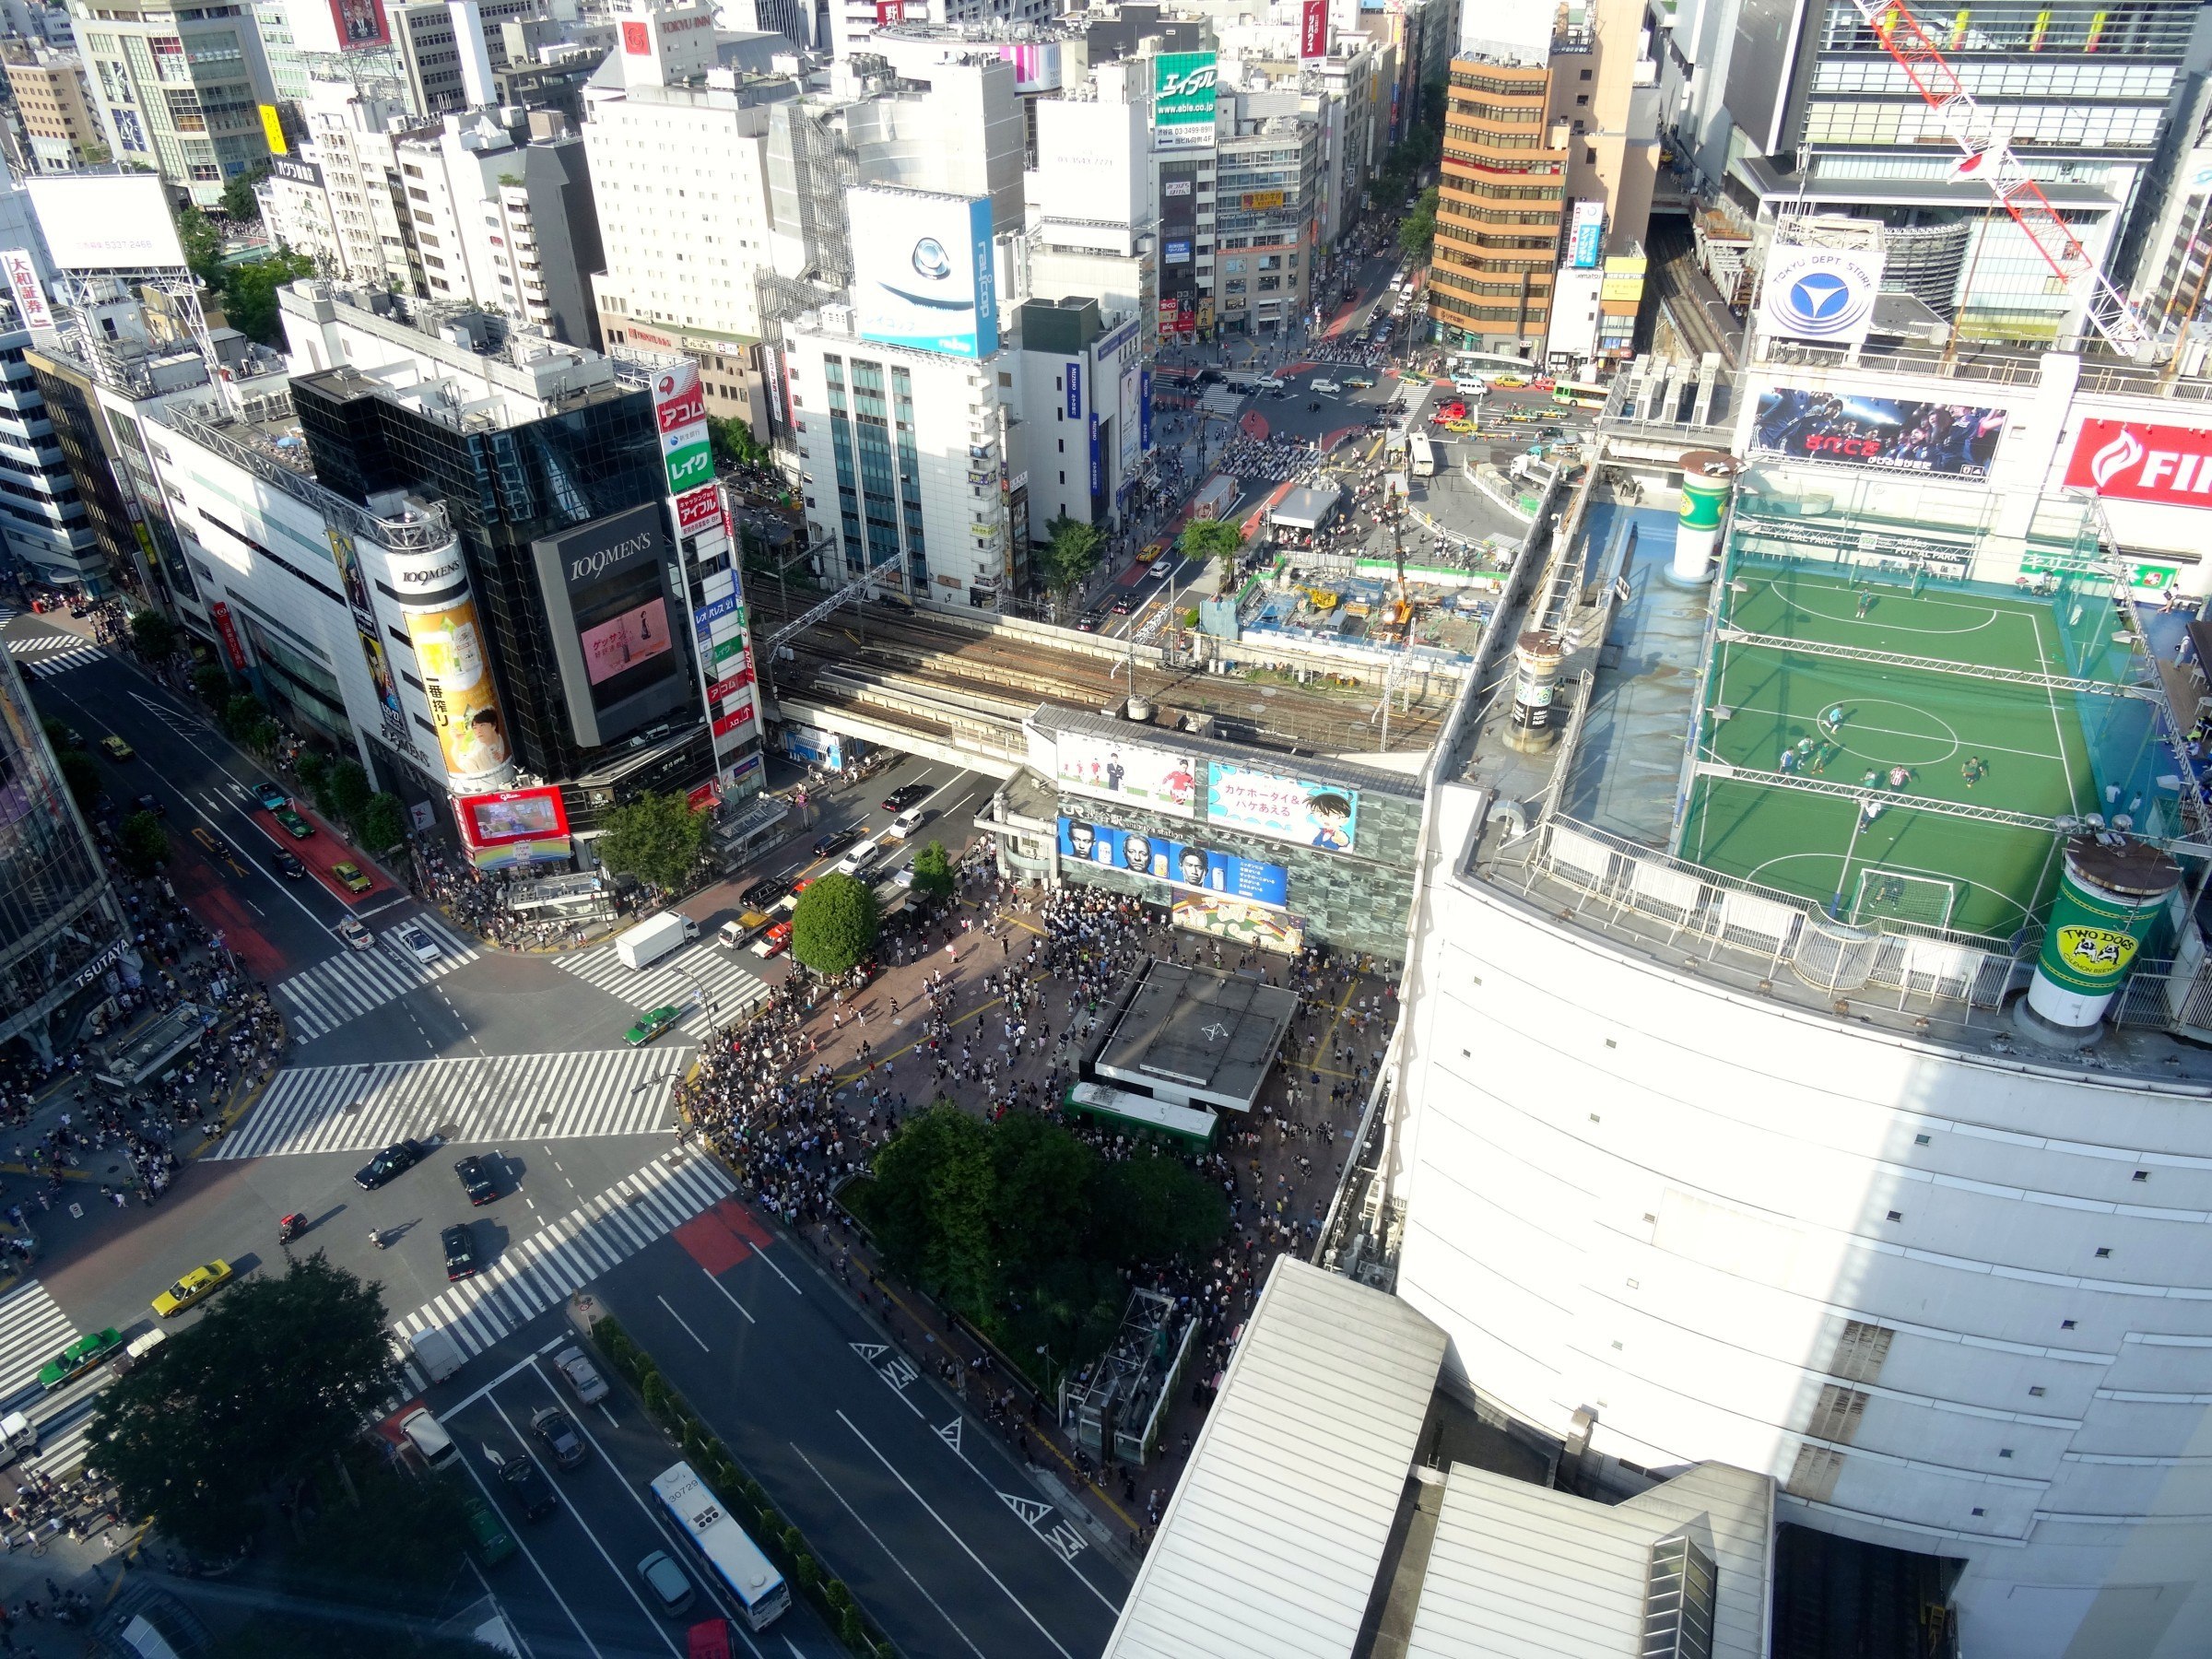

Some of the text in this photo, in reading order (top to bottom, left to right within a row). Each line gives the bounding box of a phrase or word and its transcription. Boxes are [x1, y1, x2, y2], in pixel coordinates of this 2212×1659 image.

[662, 15, 712, 33] TOKYU INN
[1306, 15, 1315, 53] リハウス
[1159, 65, 1217, 99] エイブル
[1158, 103, 1214, 114] www.able.co.jp
[1772, 255, 1872, 290] TOKYU DEPT. STORE
[10, 258, 44, 314] 大和証券
[661, 400, 704, 428] アコム
[1805, 433, 1881, 456] すべてを
[671, 452, 708, 480] レイク
[680, 499, 716, 522] アイフル
[711, 680, 736, 699] アコム
[426, 677, 449, 726] 一番搾り
[730, 718, 740, 728] 入口
[1063, 804, 1084, 818] JR
[2064, 928, 2135, 951] TWO DOGS
[75, 938, 129, 987] TSUTAYA
[2070, 959, 2093, 974] LEMON
[668, 1479, 699, 1503] 30729
